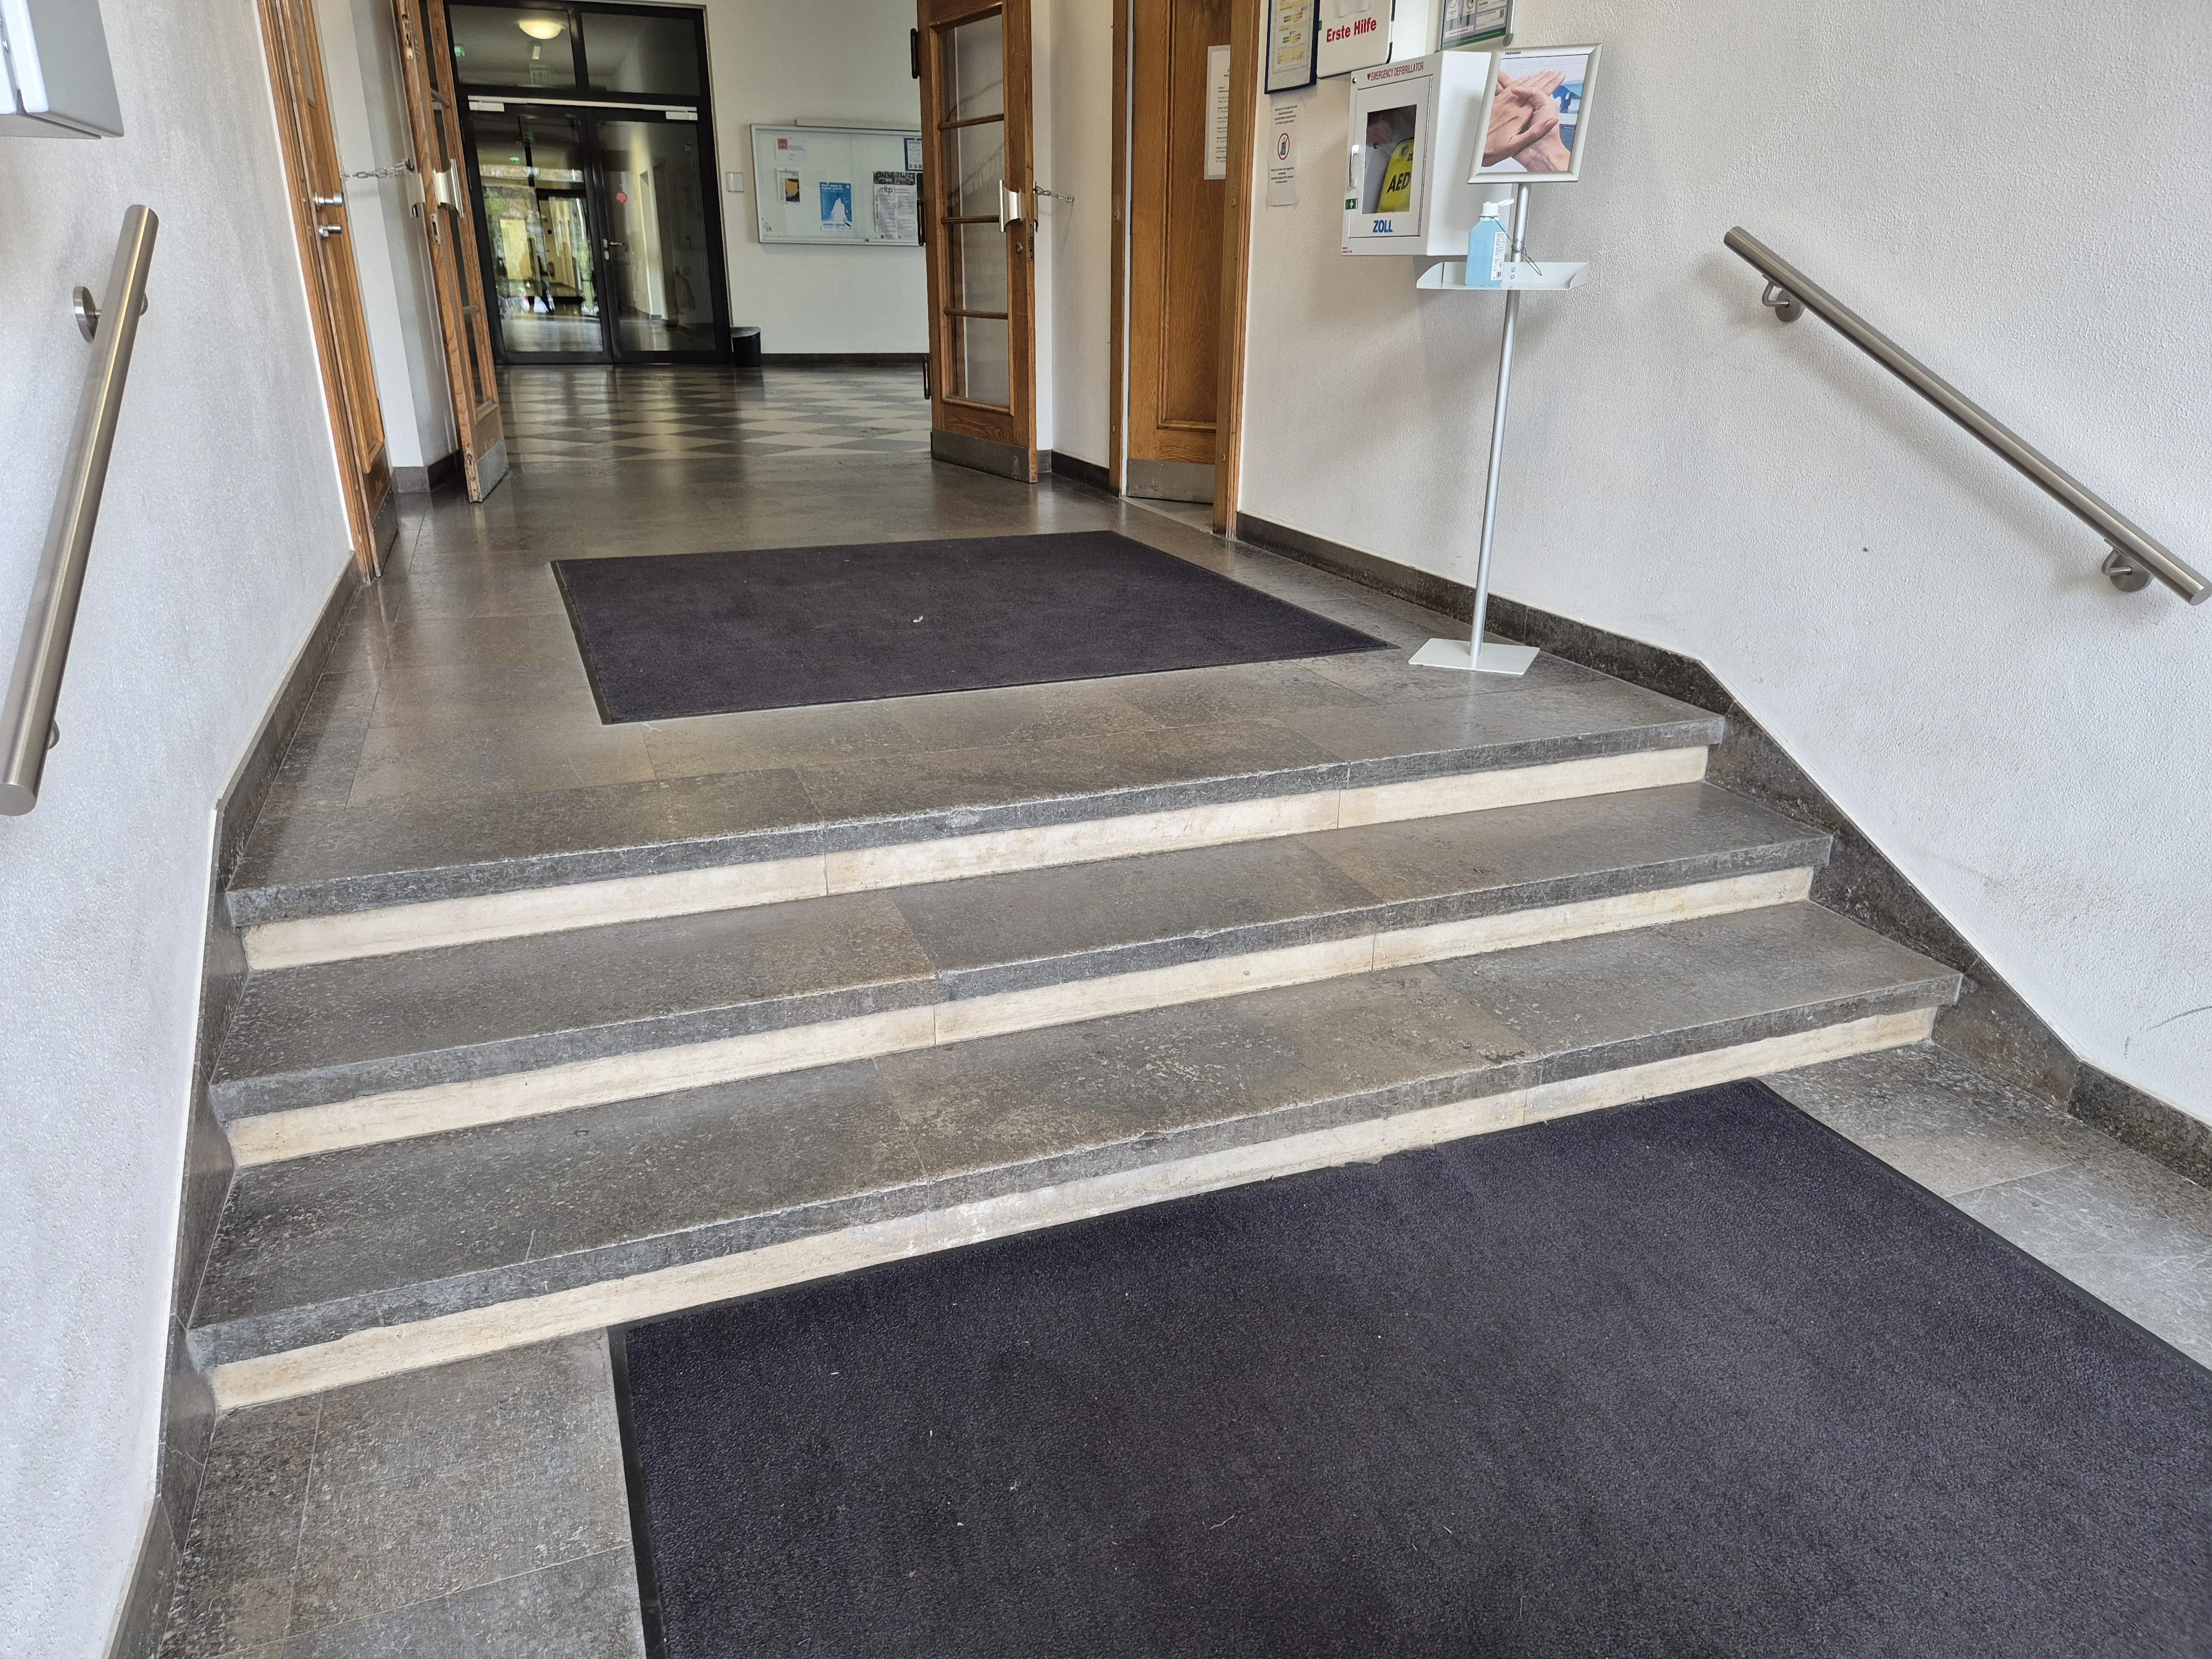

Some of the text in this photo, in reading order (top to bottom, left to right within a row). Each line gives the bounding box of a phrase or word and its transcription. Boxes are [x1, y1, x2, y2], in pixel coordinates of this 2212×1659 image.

[1327, 17, 1377, 43] Erste Hilfe
[1371, 61, 1424, 81] EMERGENCY DEFIBRILLATOR
[1386, 171, 1411, 194] AED
[1373, 220, 1393, 233] ZOLL
